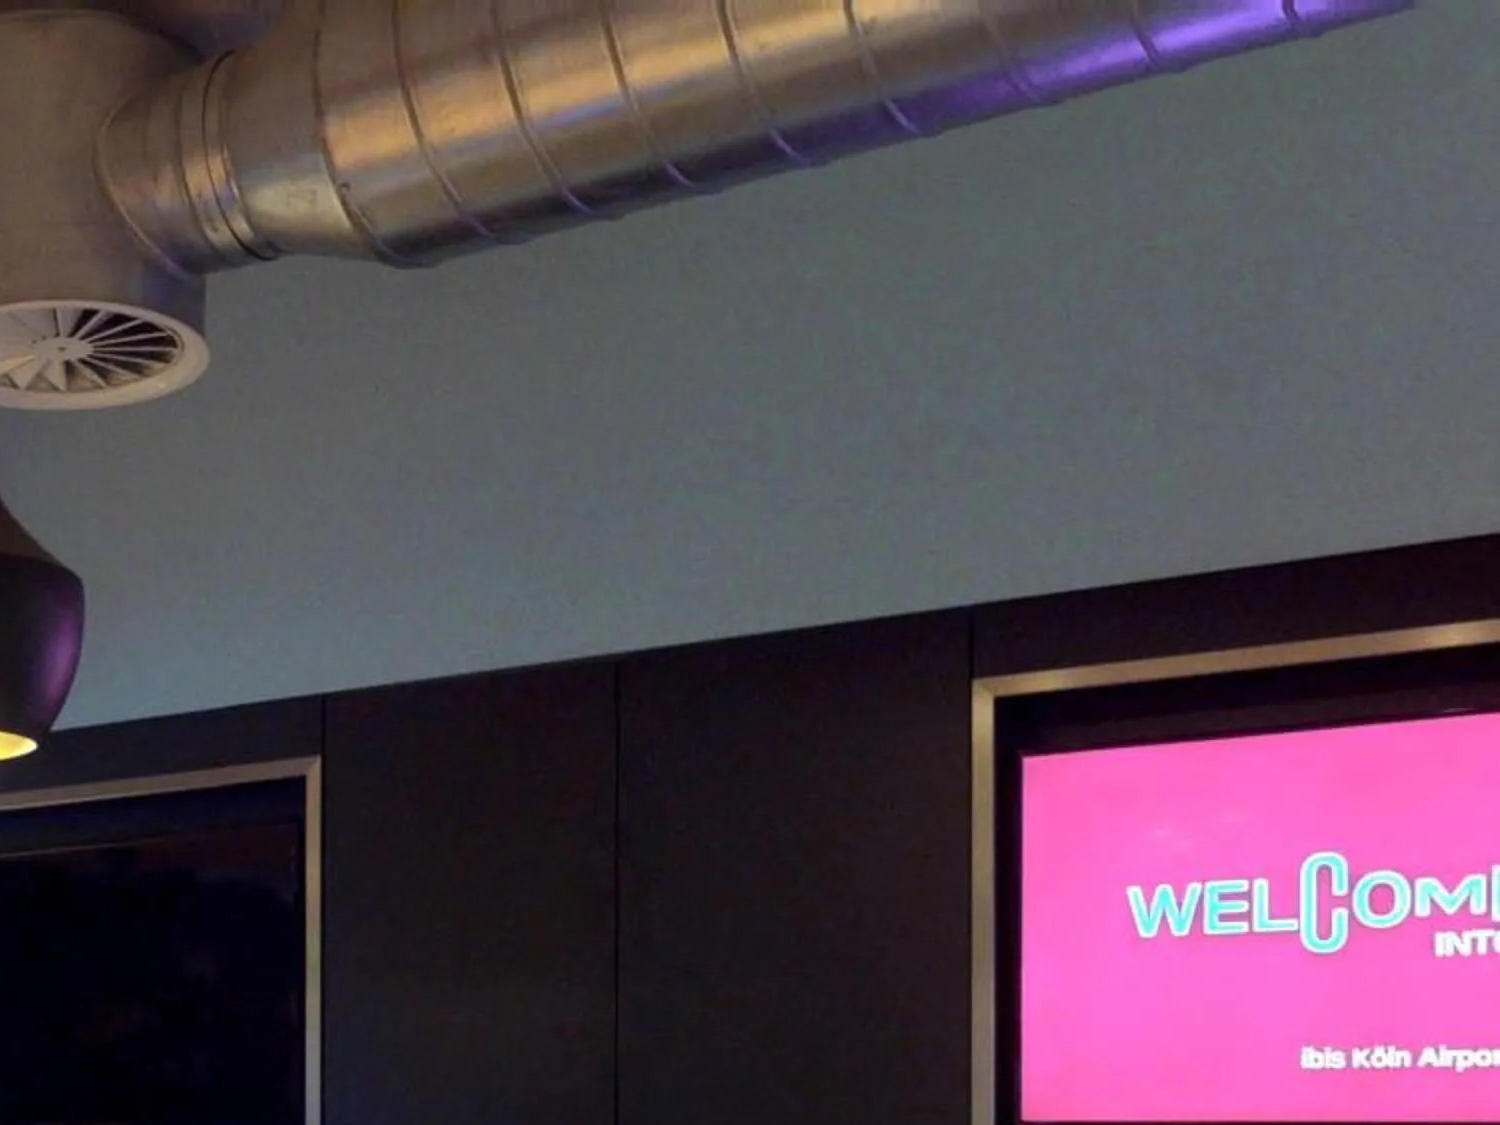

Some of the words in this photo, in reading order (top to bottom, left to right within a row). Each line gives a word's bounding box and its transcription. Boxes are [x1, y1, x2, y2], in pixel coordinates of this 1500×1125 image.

[1126, 851, 1500, 954] WELCOM
[1300, 1045, 1346, 1070] ibis
[1352, 1044, 1412, 1069] Köln
